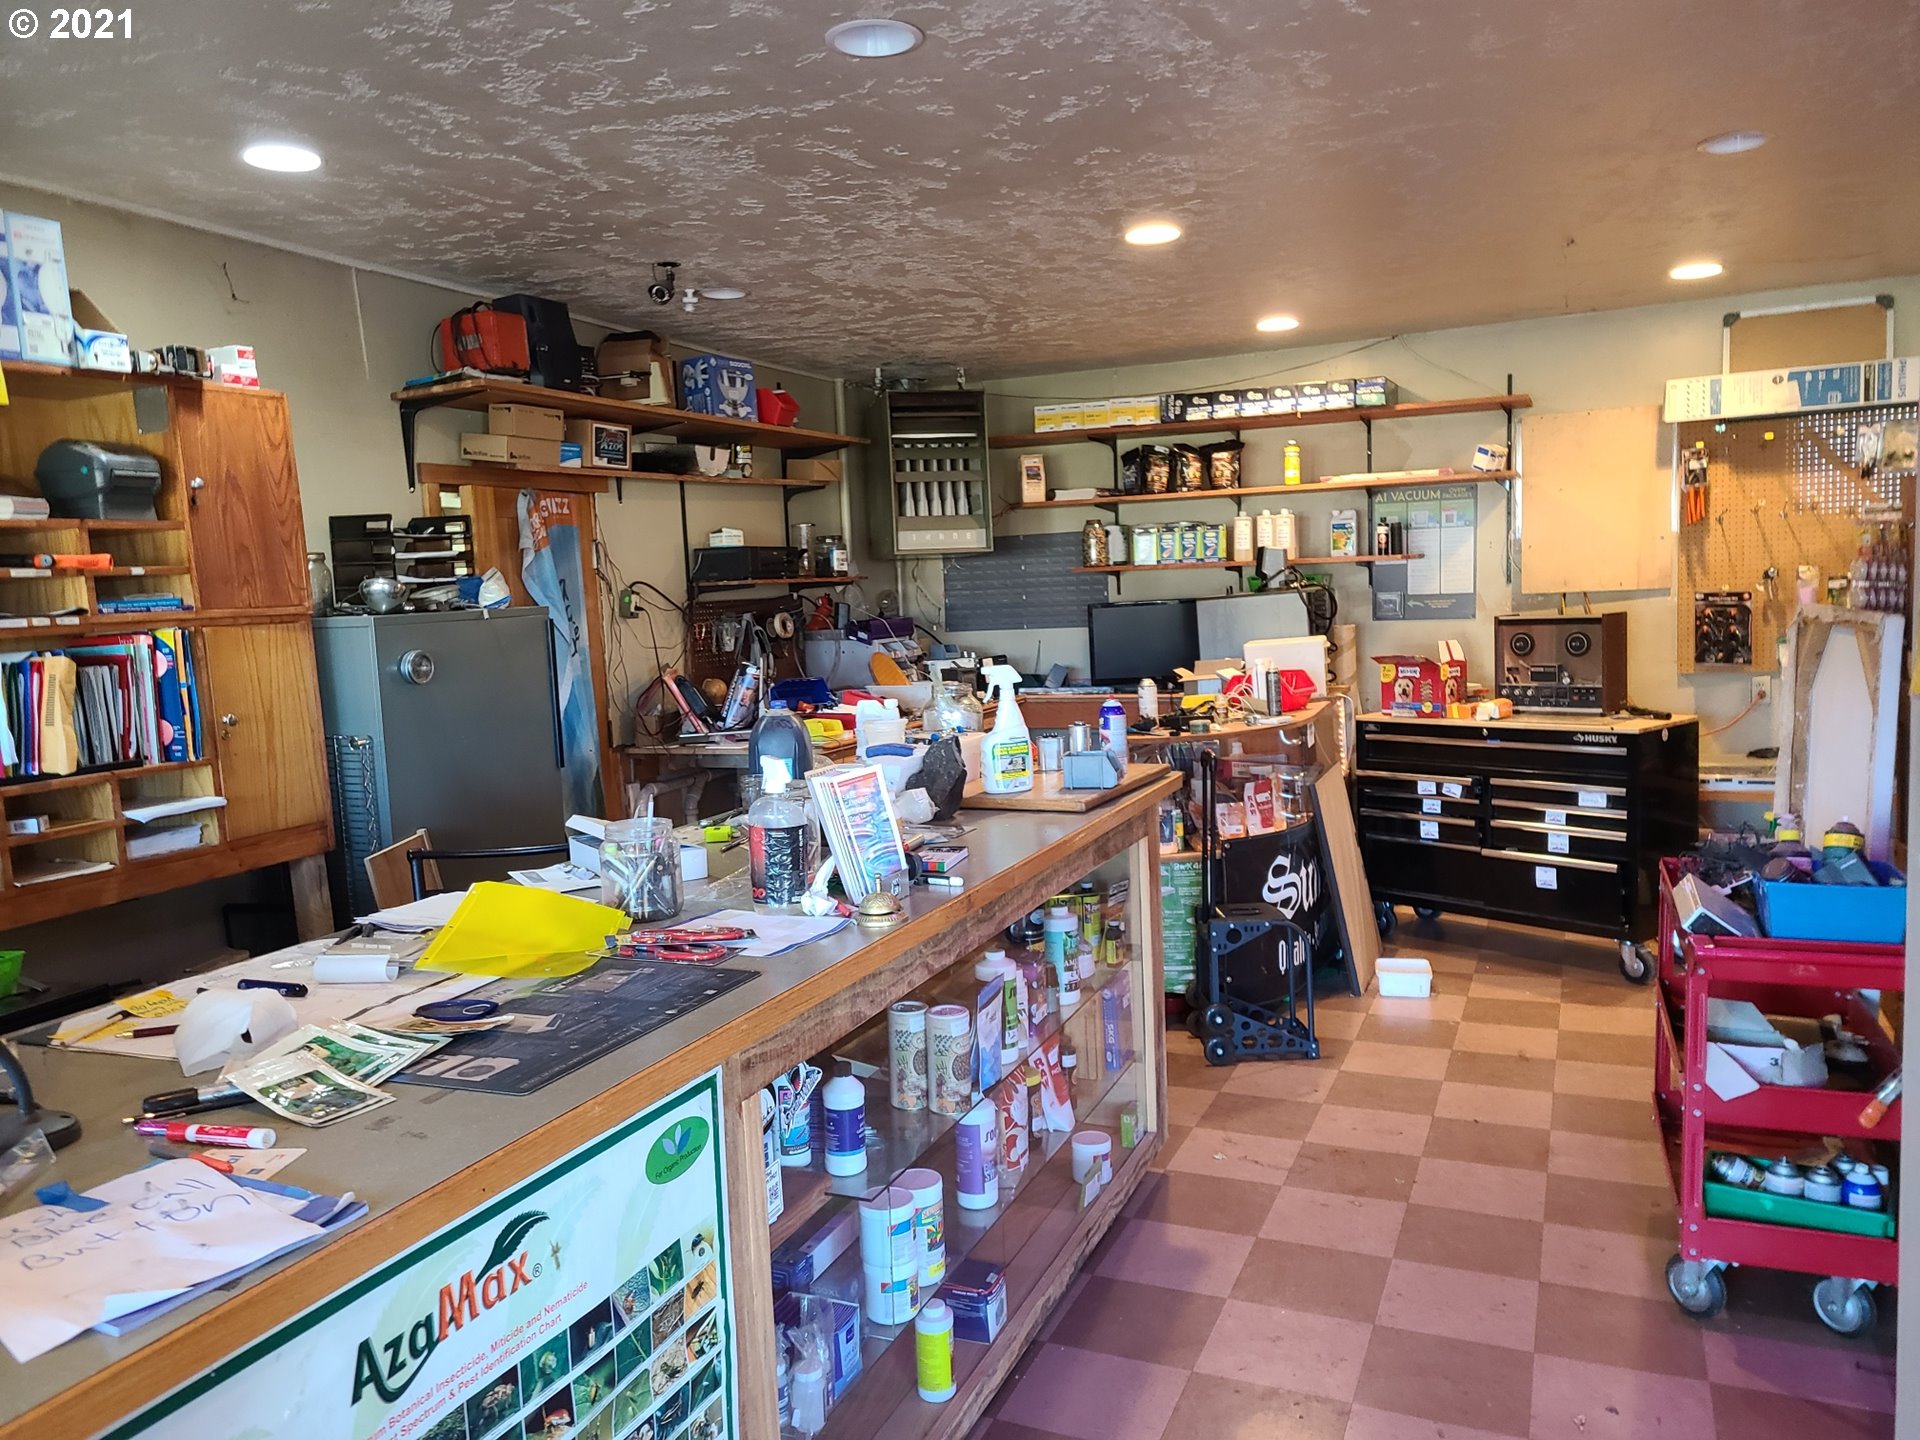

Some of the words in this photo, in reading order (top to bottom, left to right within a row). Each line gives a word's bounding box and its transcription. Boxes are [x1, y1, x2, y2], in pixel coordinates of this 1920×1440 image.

[1391, 489, 1440, 502] VACUUM
[1585, 734, 1618, 744] HUSKY
[1034, 1058, 1050, 1090] RAW
[663, 1159, 680, 1173] Organic
[680, 1144, 702, 1162] Production
[388, 1390, 434, 1430] Botanical
[435, 1353, 488, 1393] Insecticide,
[490, 1324, 525, 1354] Miticide
[525, 1313, 543, 1329] and
[543, 1281, 589, 1317] Nematicide
[399, 1396, 447, 1437] Spectrum
[448, 1388, 457, 1401] &
[457, 1371, 480, 1394] Pest
[480, 1330, 538, 1377] Identification
[538, 1312, 563, 1335] Chart
